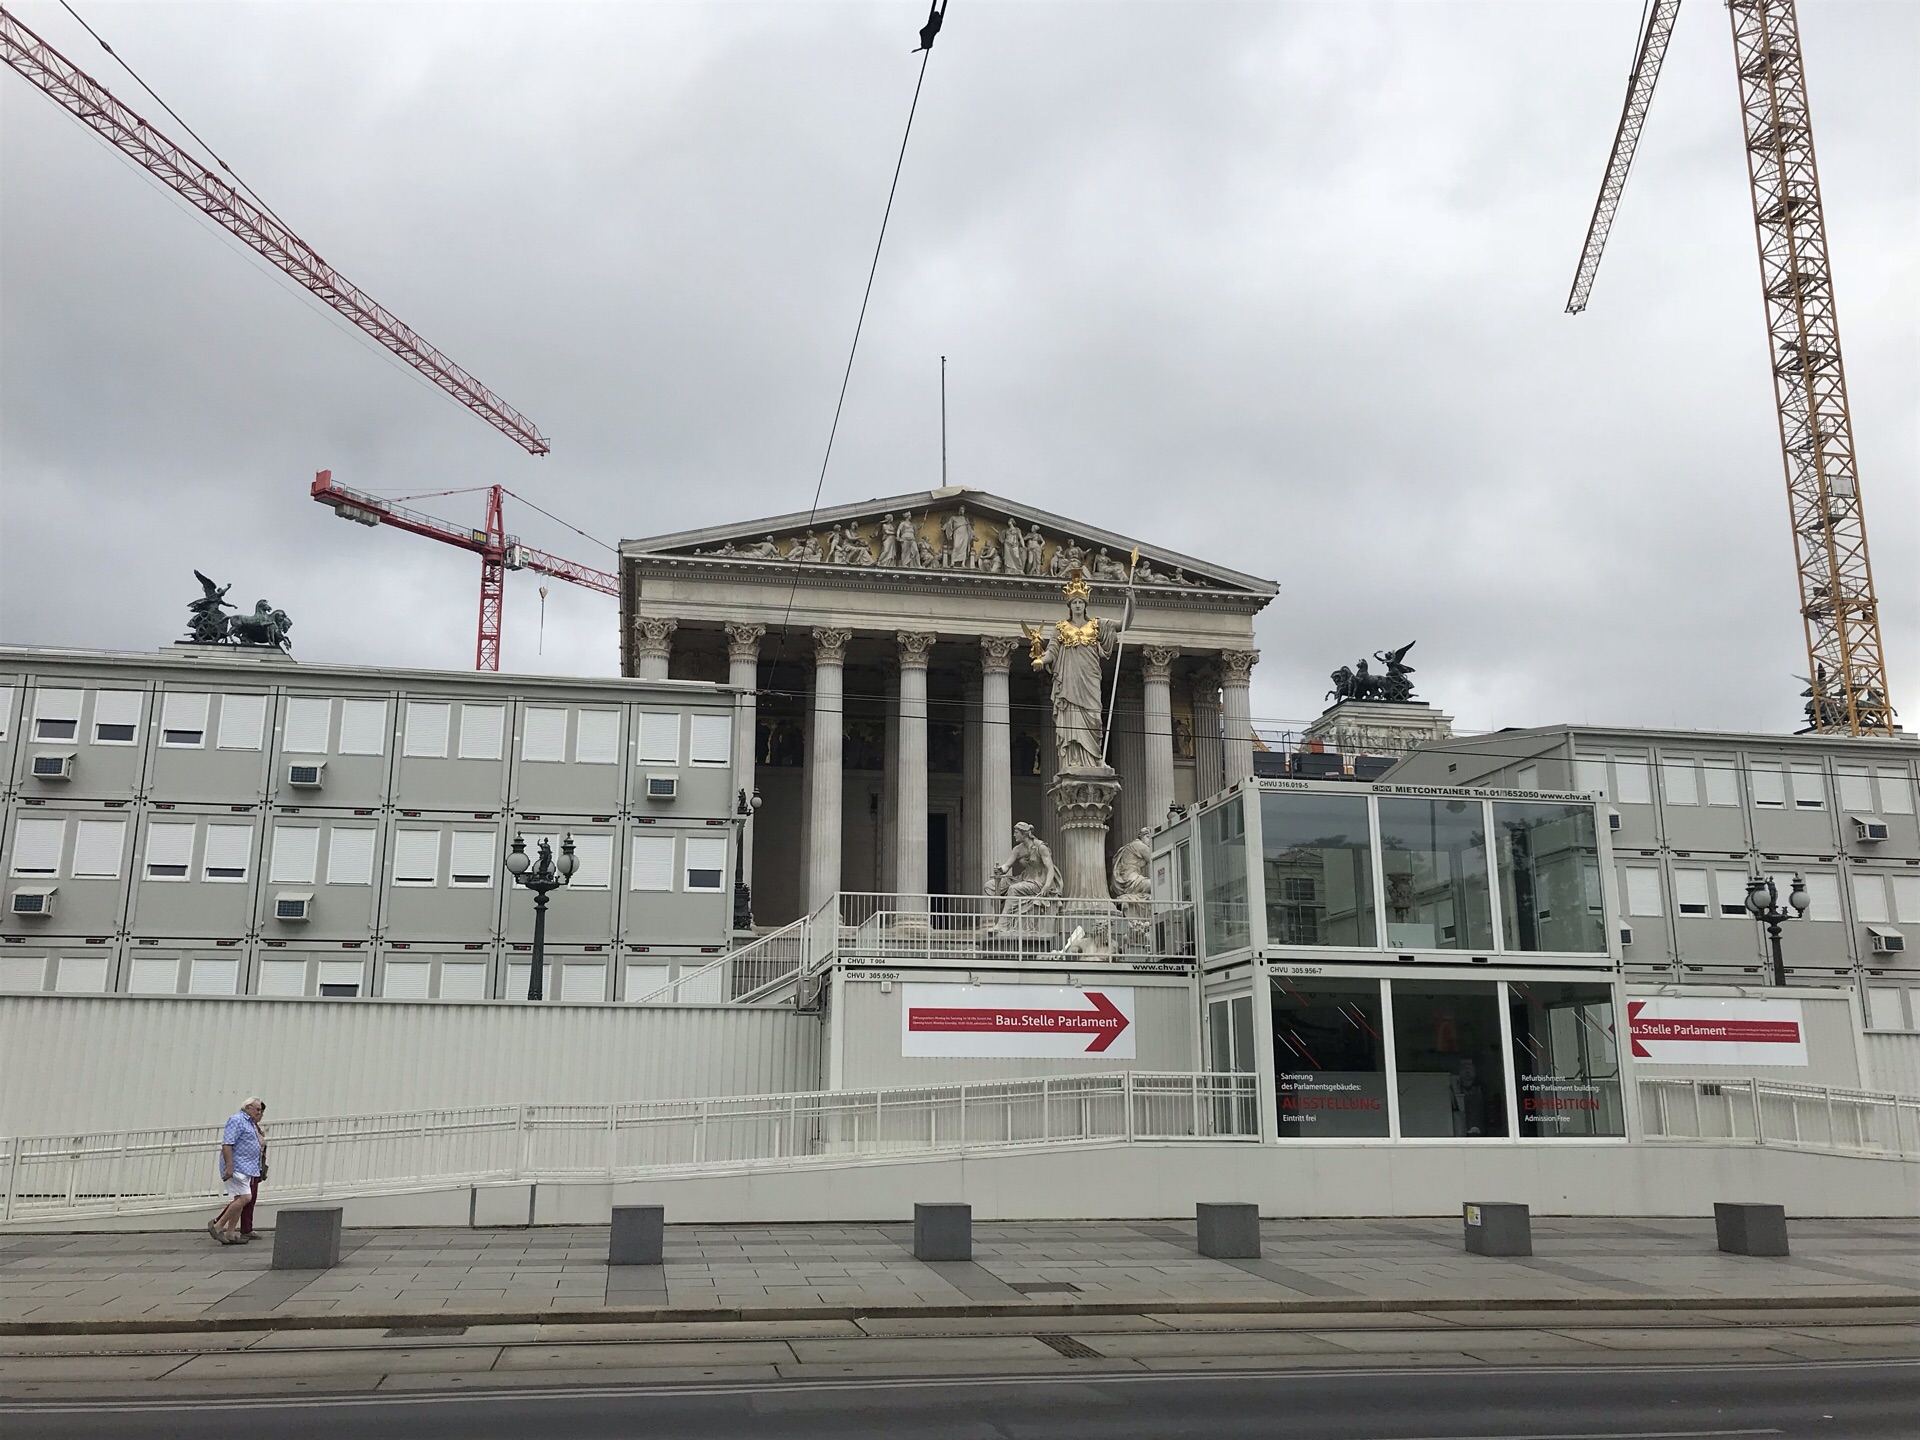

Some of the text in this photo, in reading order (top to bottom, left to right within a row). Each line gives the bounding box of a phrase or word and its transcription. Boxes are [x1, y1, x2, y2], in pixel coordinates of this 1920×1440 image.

[1395, 786, 1470, 796] MIETCONTAINER
[1540, 792, 1591, 800] www.chv.at
[996, 1014, 1054, 1026] Bau.Stelle
[1058, 1016, 1118, 1027] Parlament
[1674, 1024, 1726, 1035] Parlament
[1280, 1072, 1313, 1081] Sanierung
[1294, 1083, 1362, 1092] Parlamentsgebäudes:
[1282, 1096, 1380, 1110] AUSSTELLUNG
[1524, 1098, 1600, 1110] EXHIBITION
